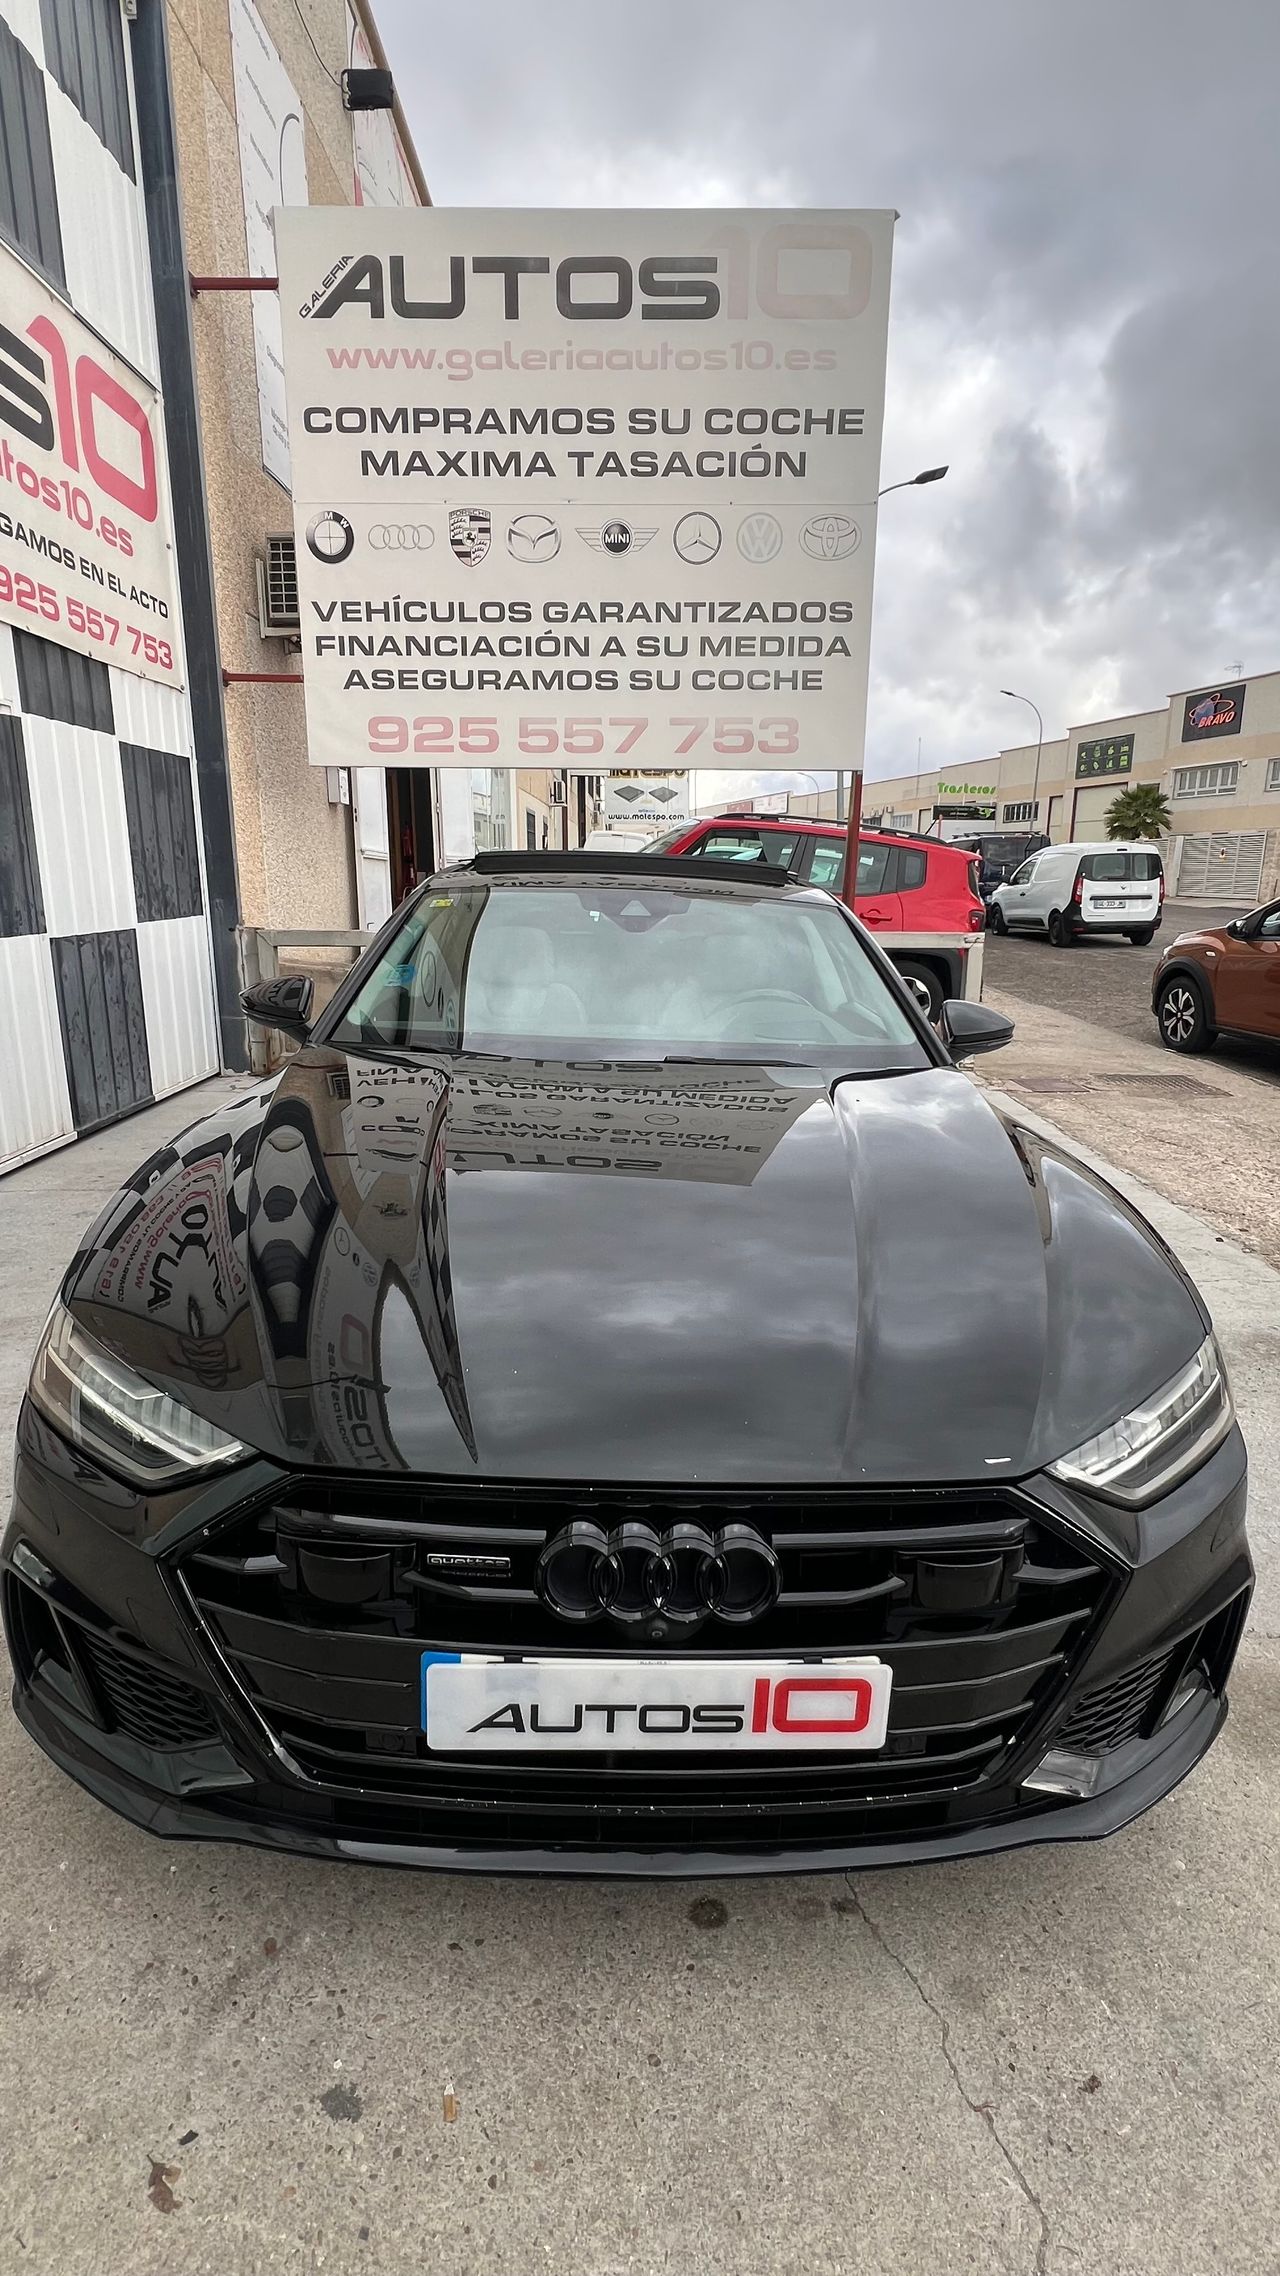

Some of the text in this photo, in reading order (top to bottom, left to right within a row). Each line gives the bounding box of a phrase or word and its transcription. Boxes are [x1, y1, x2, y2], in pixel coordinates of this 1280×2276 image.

[298, 254, 354, 319] GALERIA
[326, 339, 837, 381] www.galeriaautos10.es
[303, 406, 616, 436] COMPRAMOS
[627, 407, 692, 436] SU
[703, 407, 865, 436] COCHE
[360, 444, 807, 478] MAXIMA TASACIÓN
[604, 532, 630, 544] MINI
[79, 556, 105, 587] EN
[108, 572, 127, 598] EL
[129, 585, 169, 620] ACTO
[311, 595, 854, 624] VEHÍCULOS GARANTIZADOS
[66, 596, 120, 647] 557
[126, 625, 174, 671] 753
[314, 630, 852, 658] FINANCIACIÓN A SU MEDIDA
[343, 669, 823, 692] ASEGURAMOS SU COCHE
[367, 715, 800, 754] 925 557 753
[1198, 711, 1236, 729] BRAVO
[466, 1678, 873, 1734] AUTOS10
